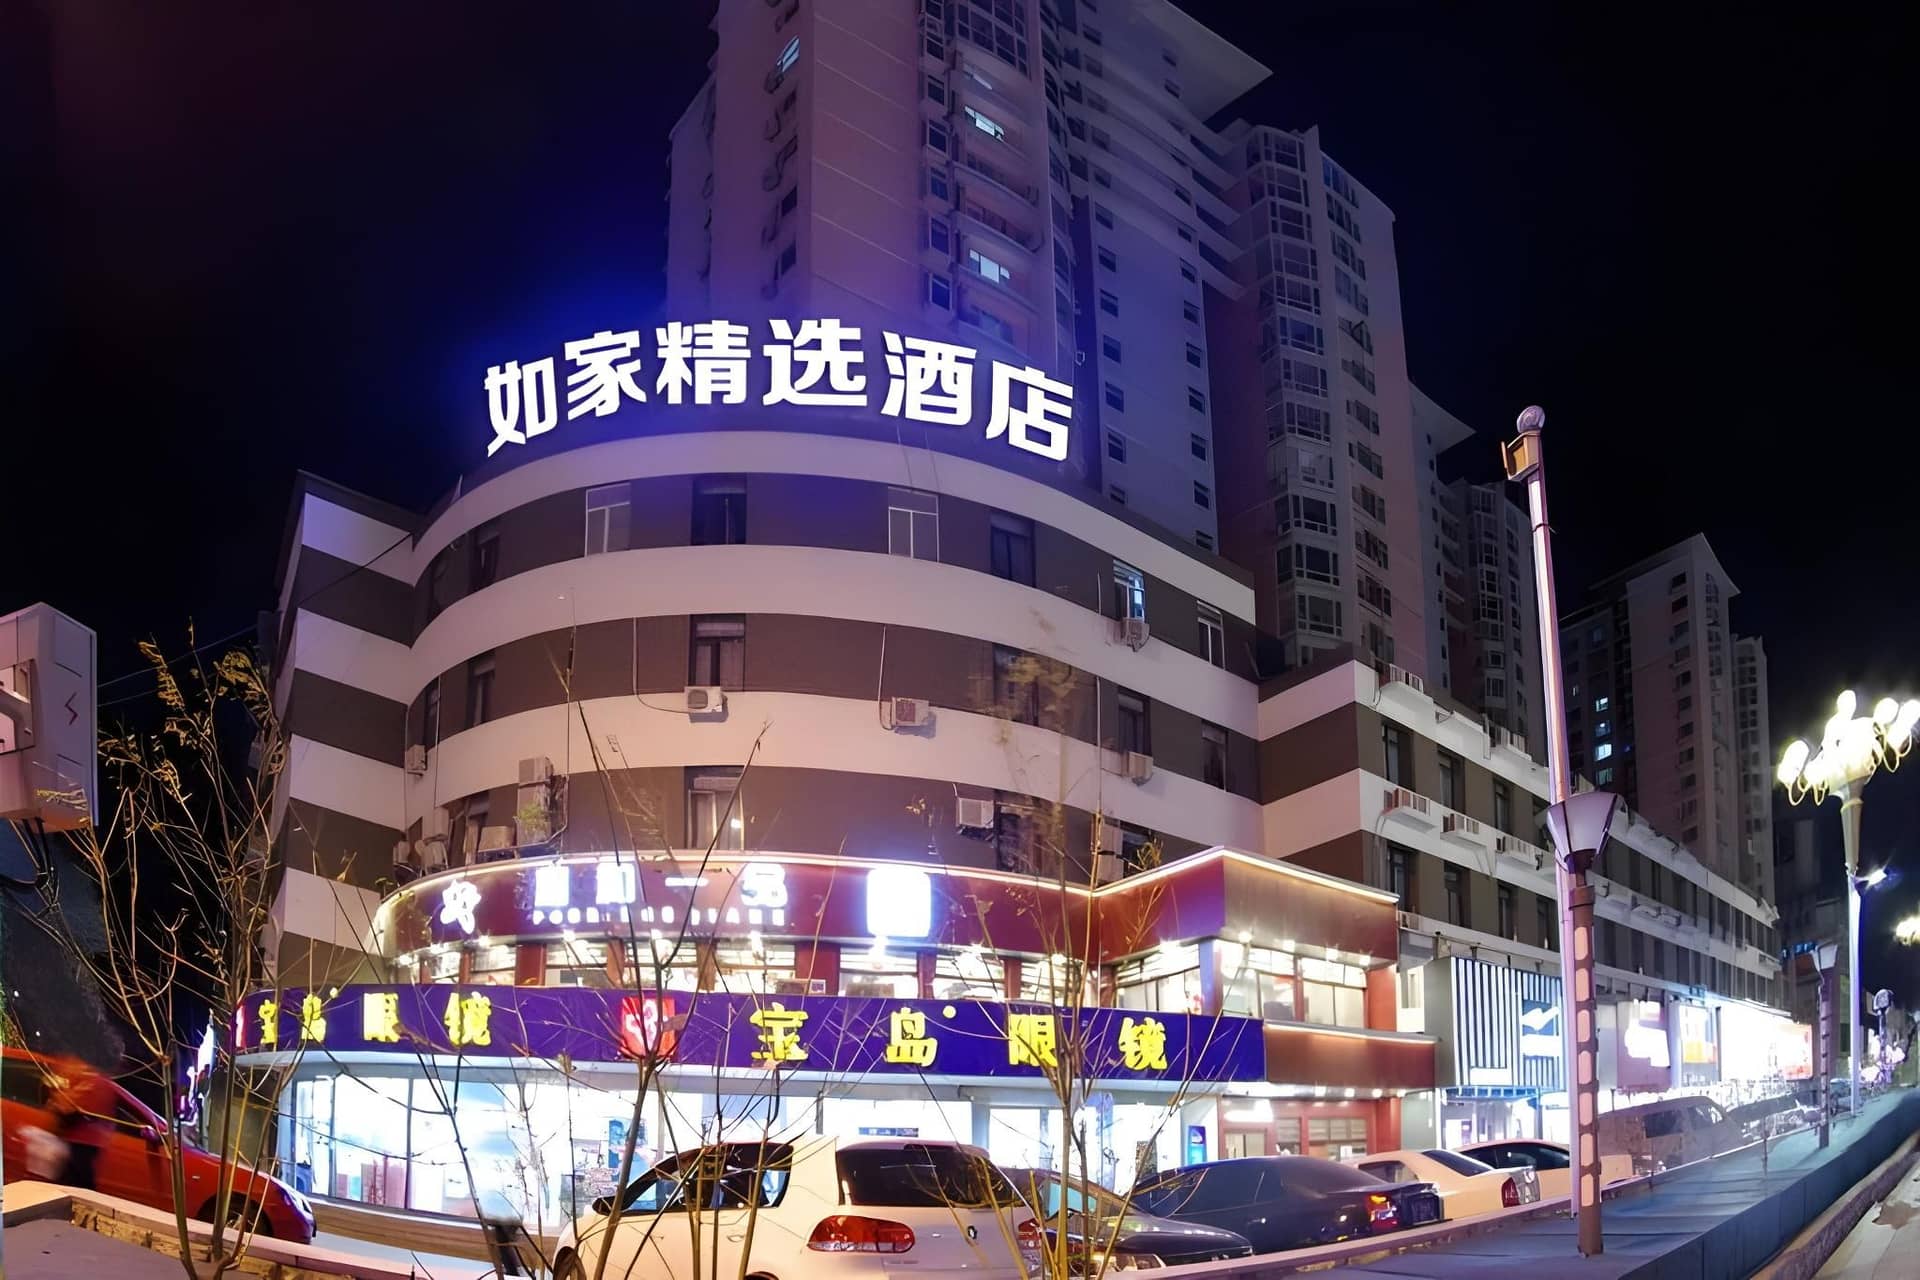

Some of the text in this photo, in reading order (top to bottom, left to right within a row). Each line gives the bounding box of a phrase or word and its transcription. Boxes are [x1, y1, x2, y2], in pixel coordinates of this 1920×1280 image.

[484, 319, 1074, 462] 如家精选酒店
[750, 1003, 1168, 1070] 宝岛眼镜
